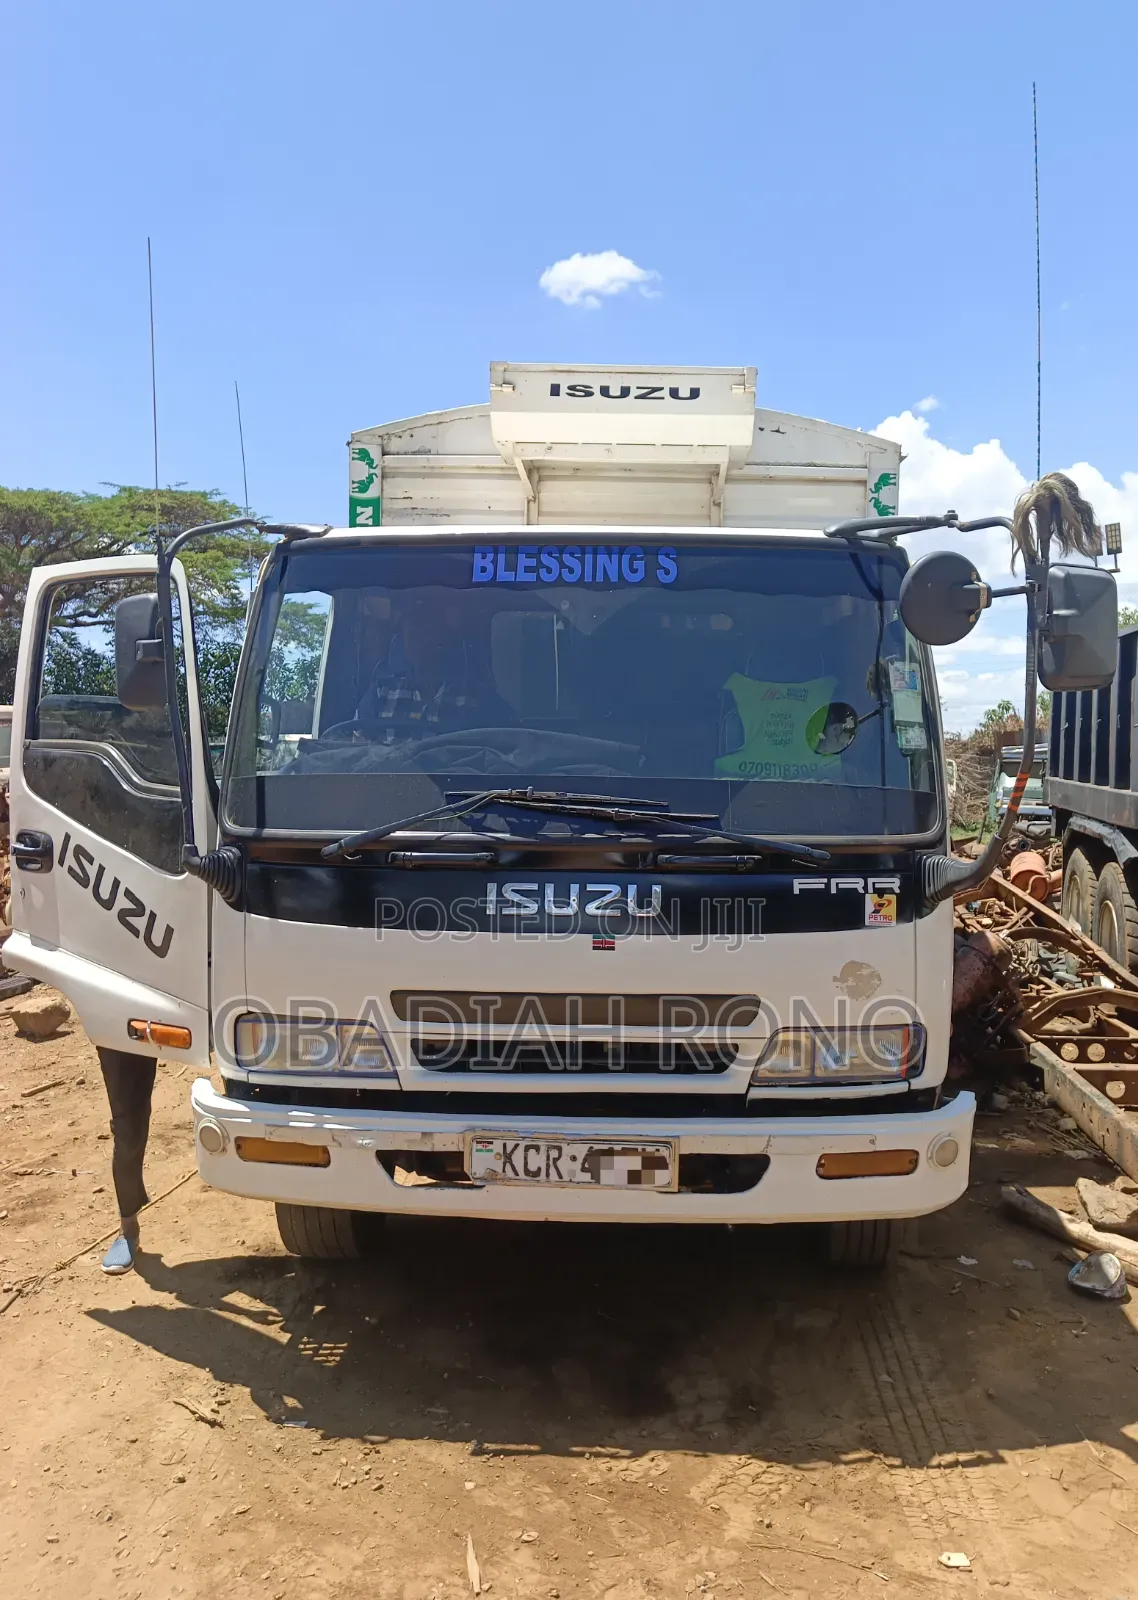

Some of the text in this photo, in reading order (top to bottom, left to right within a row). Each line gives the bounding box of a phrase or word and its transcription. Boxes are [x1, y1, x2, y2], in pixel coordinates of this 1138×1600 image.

[550, 383, 700, 400] ISUZU
[472, 545, 679, 583] BLESSING S
[58, 831, 174, 958] ISUZU
[486, 882, 662, 917] ISUZU
[793, 877, 900, 895] FRR
[868, 914, 893, 922] PETRO
[502, 1142, 563, 1180] KCR
